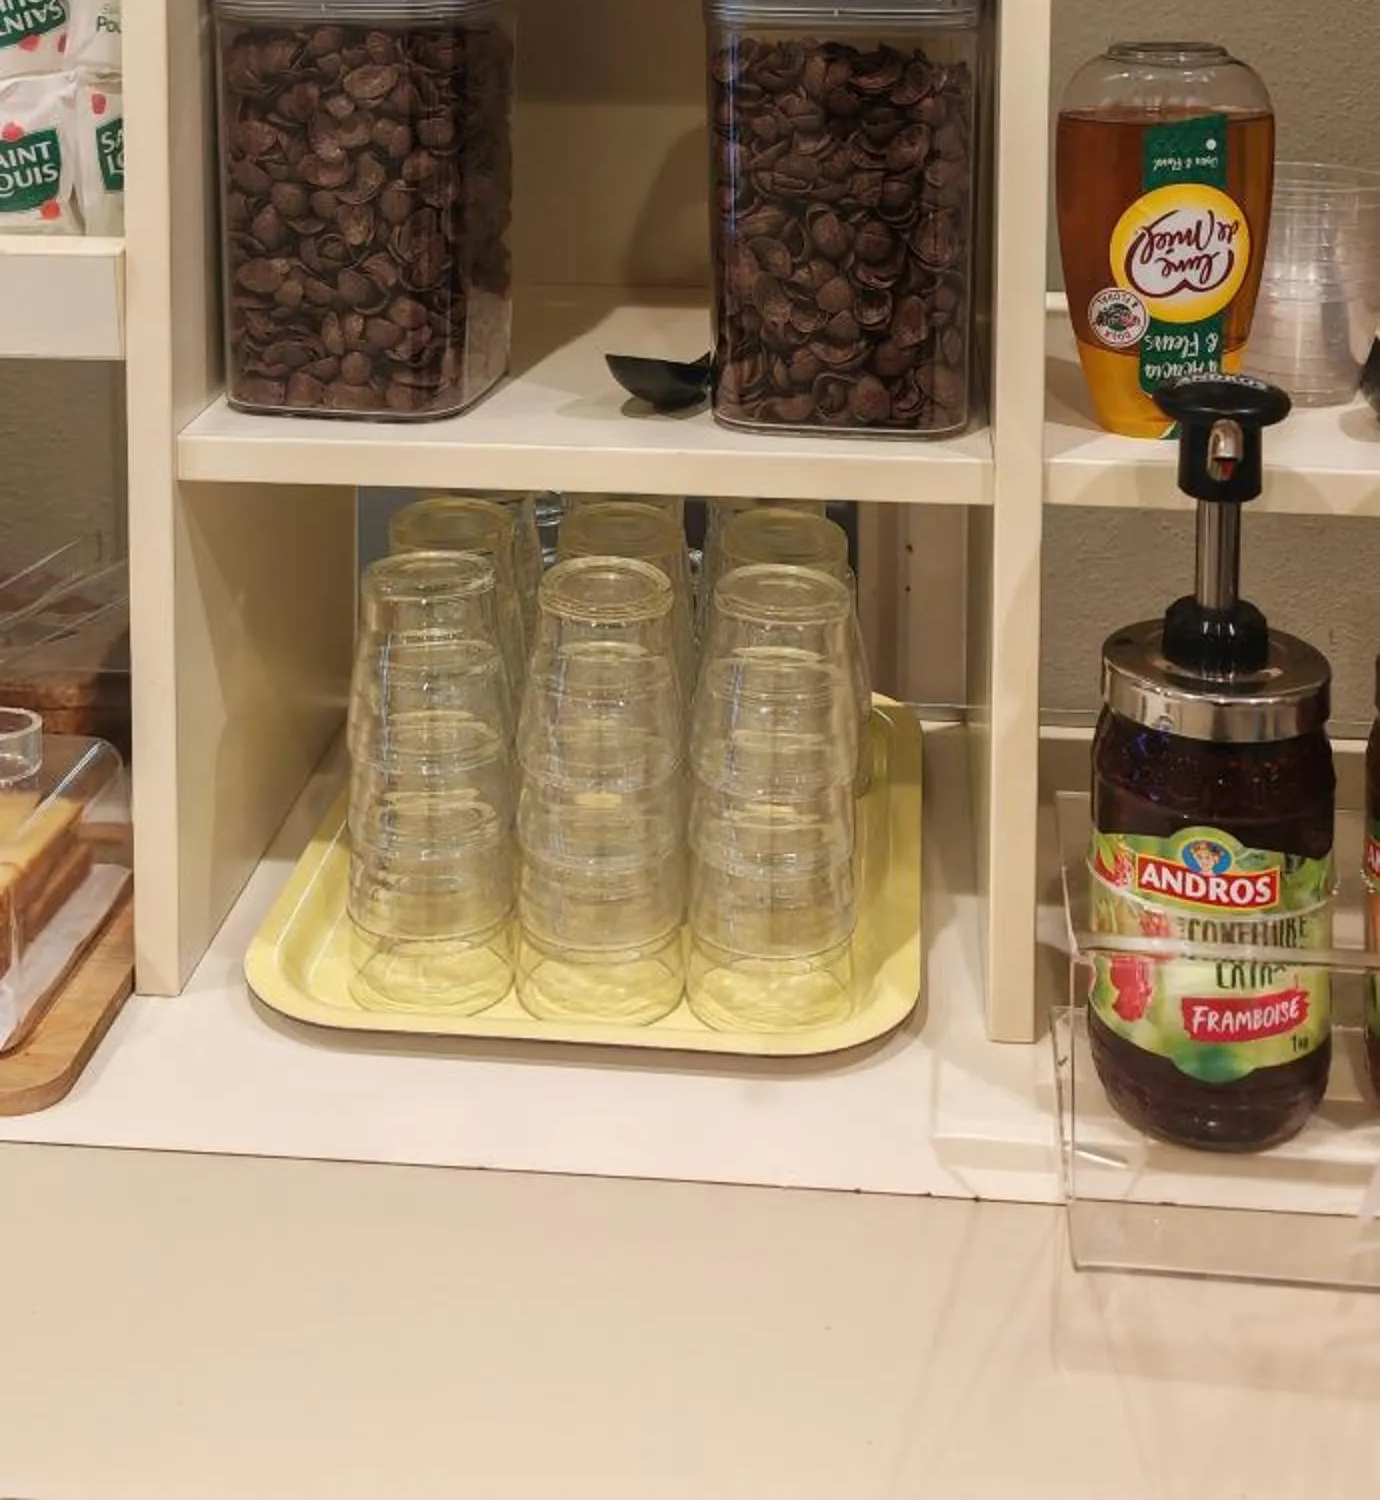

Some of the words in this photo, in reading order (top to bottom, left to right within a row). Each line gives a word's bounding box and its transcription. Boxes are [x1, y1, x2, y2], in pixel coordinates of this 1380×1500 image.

[0, 140, 52, 169] AINT
[0, 162, 58, 198] OUIS
[1144, 332, 1199, 359] Fleurs
[1140, 864, 1271, 904] ANDROS
[1193, 999, 1299, 1034] FRAMBOISE
